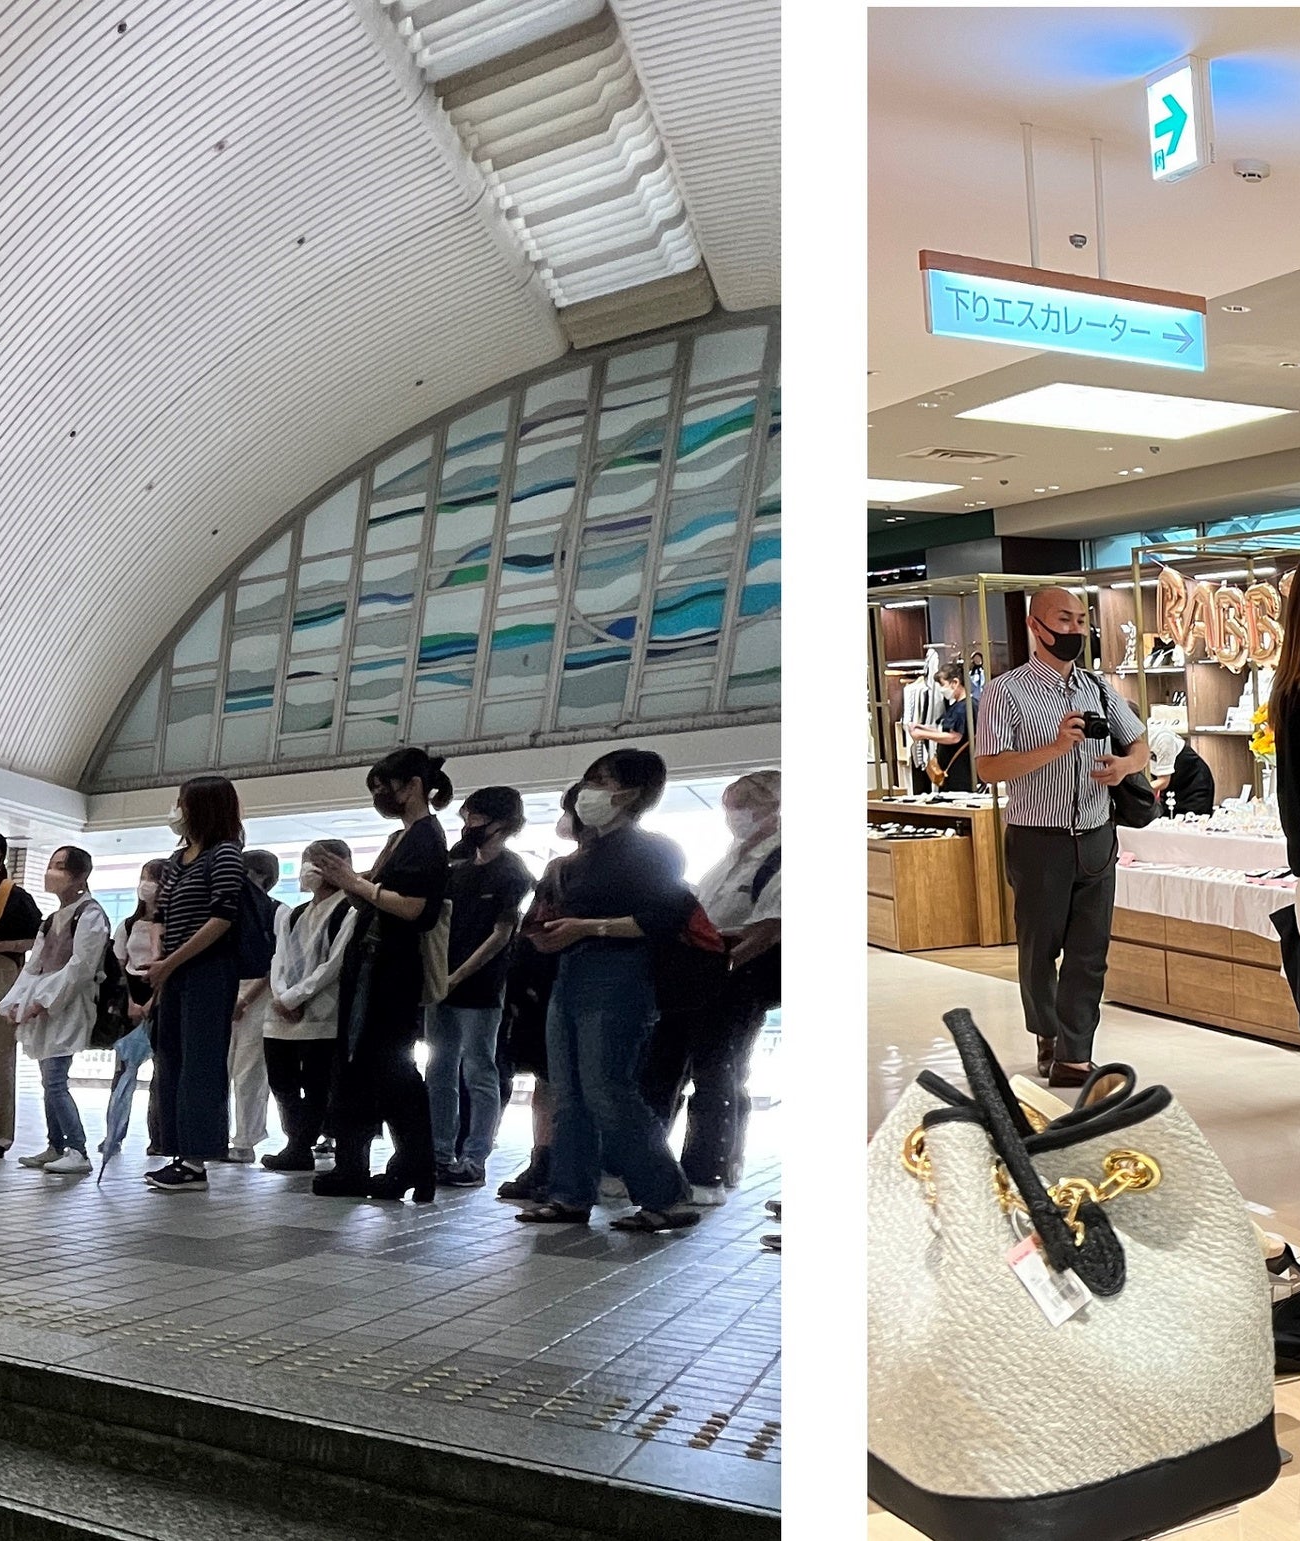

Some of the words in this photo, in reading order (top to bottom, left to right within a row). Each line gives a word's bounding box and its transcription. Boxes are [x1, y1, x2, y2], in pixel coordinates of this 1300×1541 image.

[945, 286, 1150, 342] 下りエスカレーター
[1157, 567, 1297, 674] RABB
